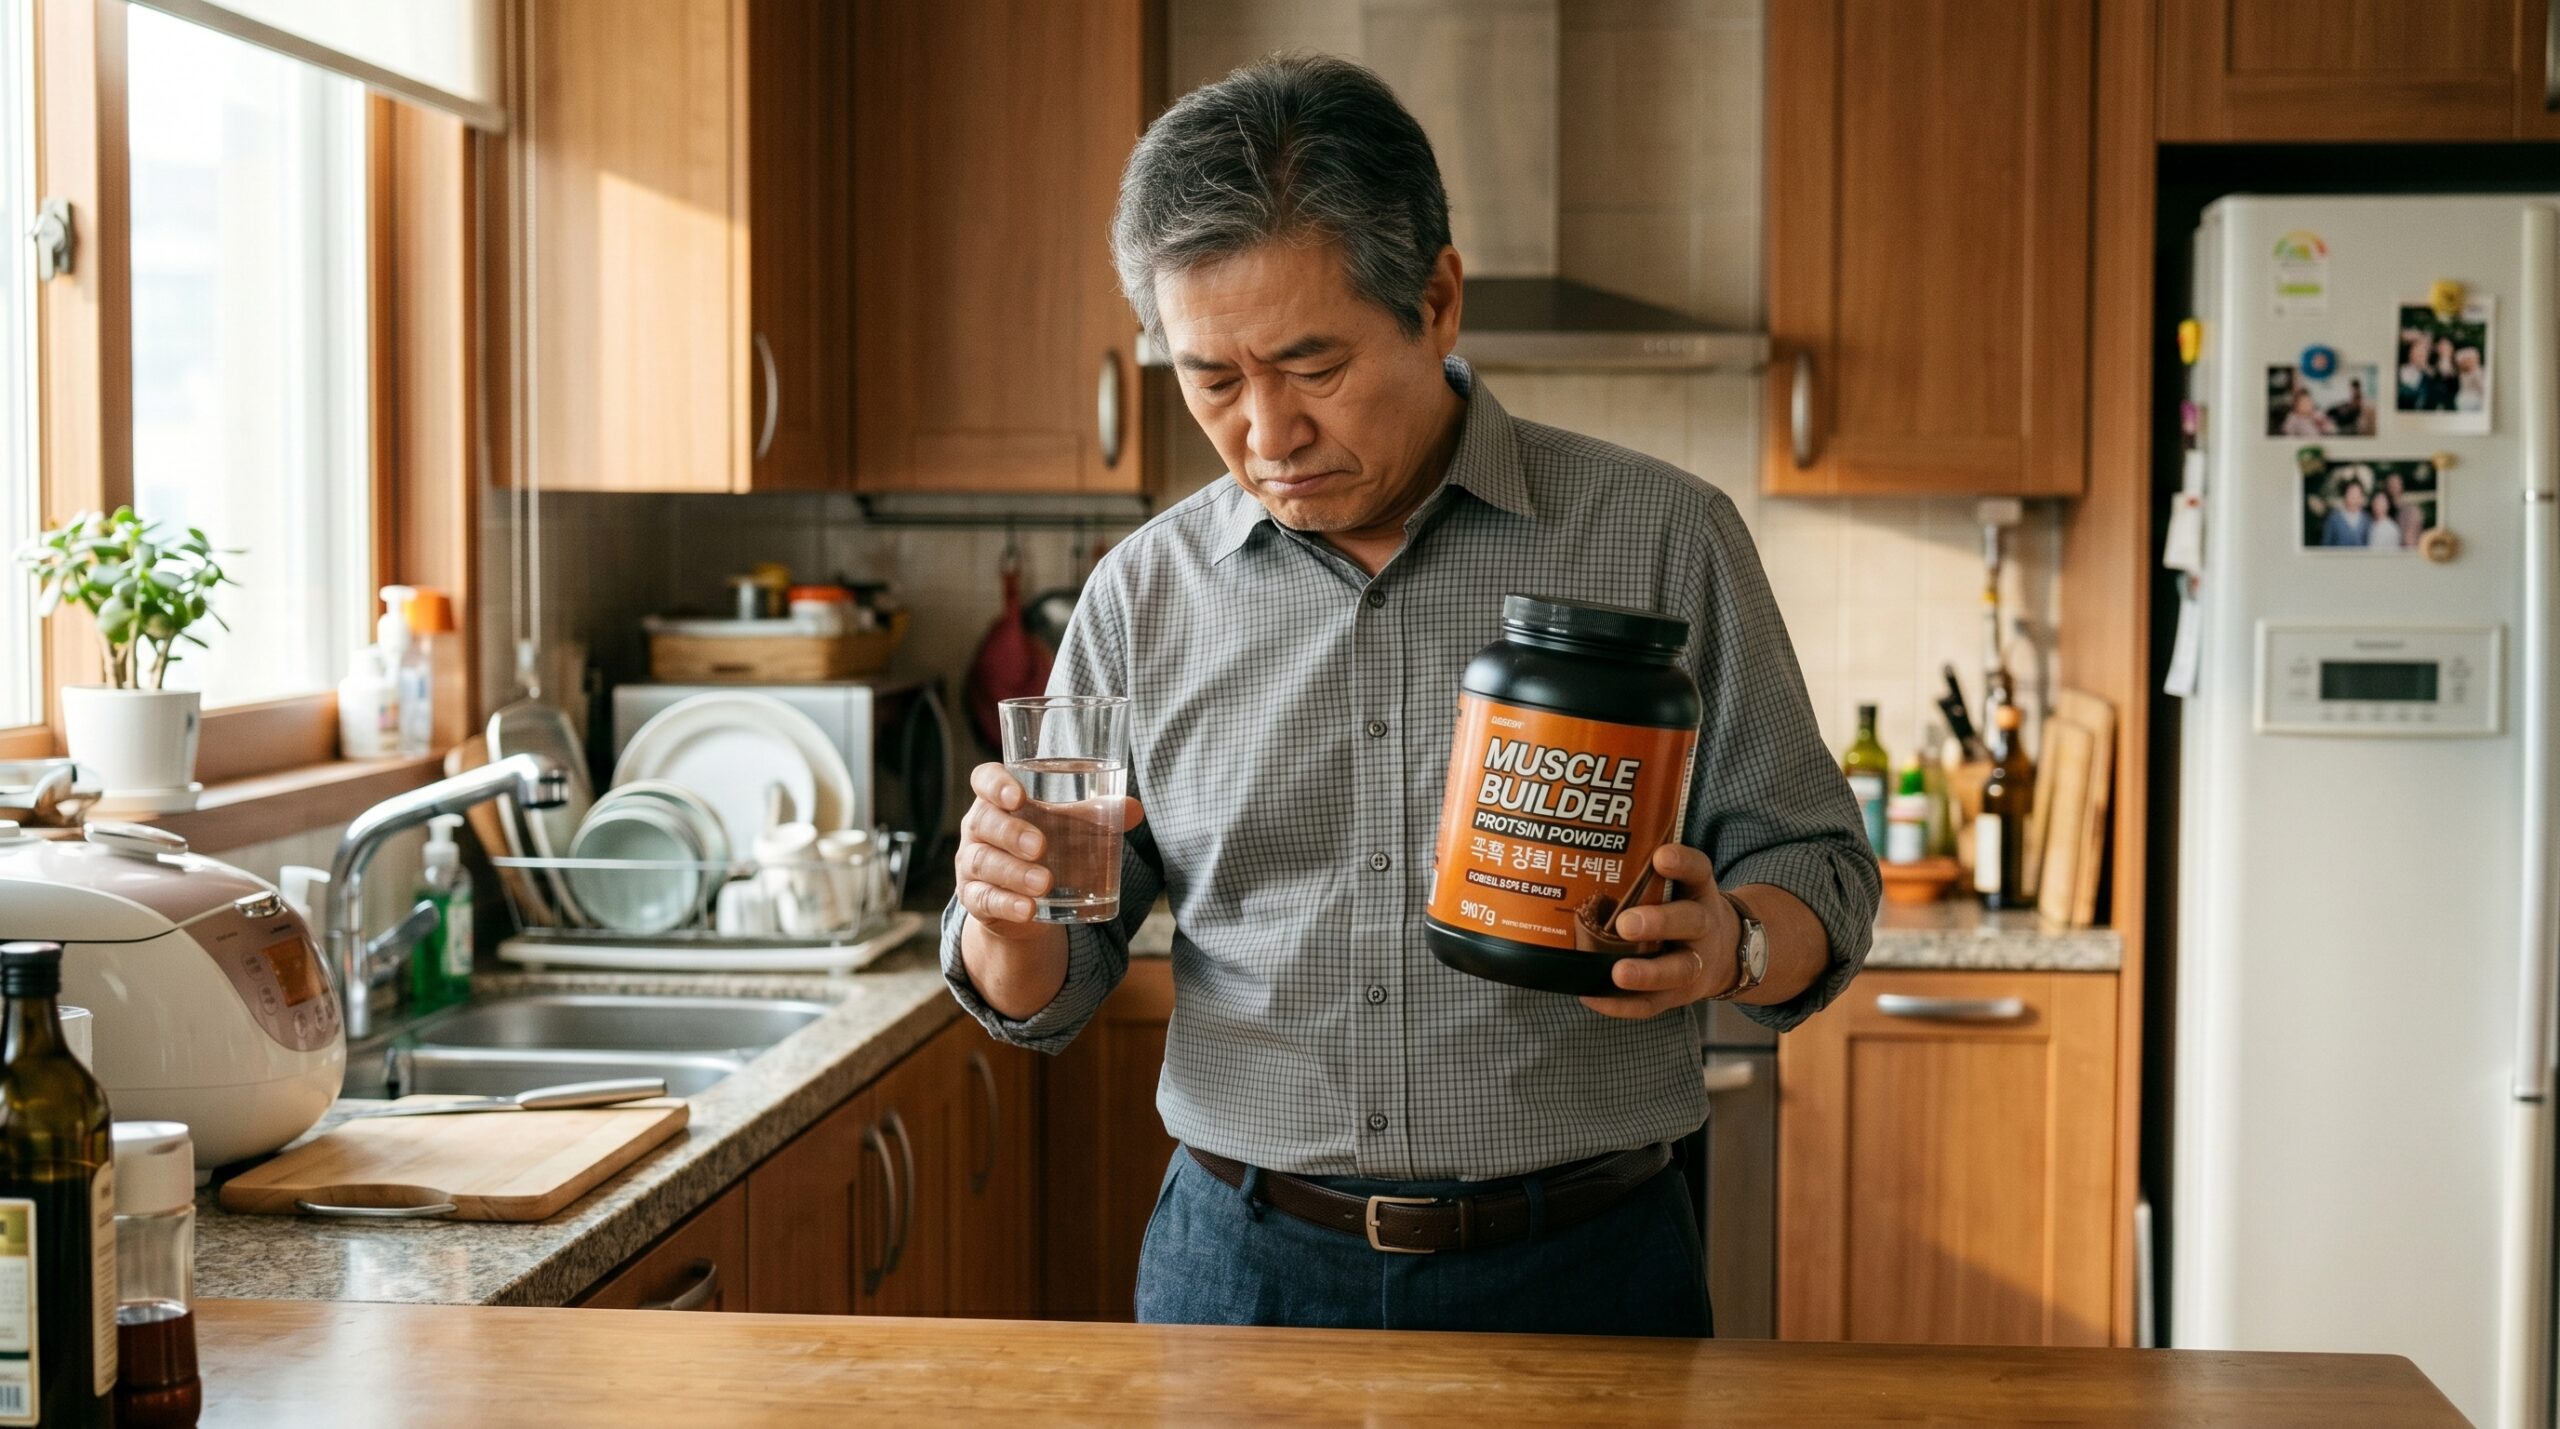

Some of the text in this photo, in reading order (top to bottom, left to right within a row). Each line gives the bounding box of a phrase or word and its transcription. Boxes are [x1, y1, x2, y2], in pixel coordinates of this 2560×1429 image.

[1483, 737, 1640, 790] MUSCLE
[1477, 772, 1633, 826] BUILDER
[1475, 811, 1625, 850] PROTSIN POWDER
